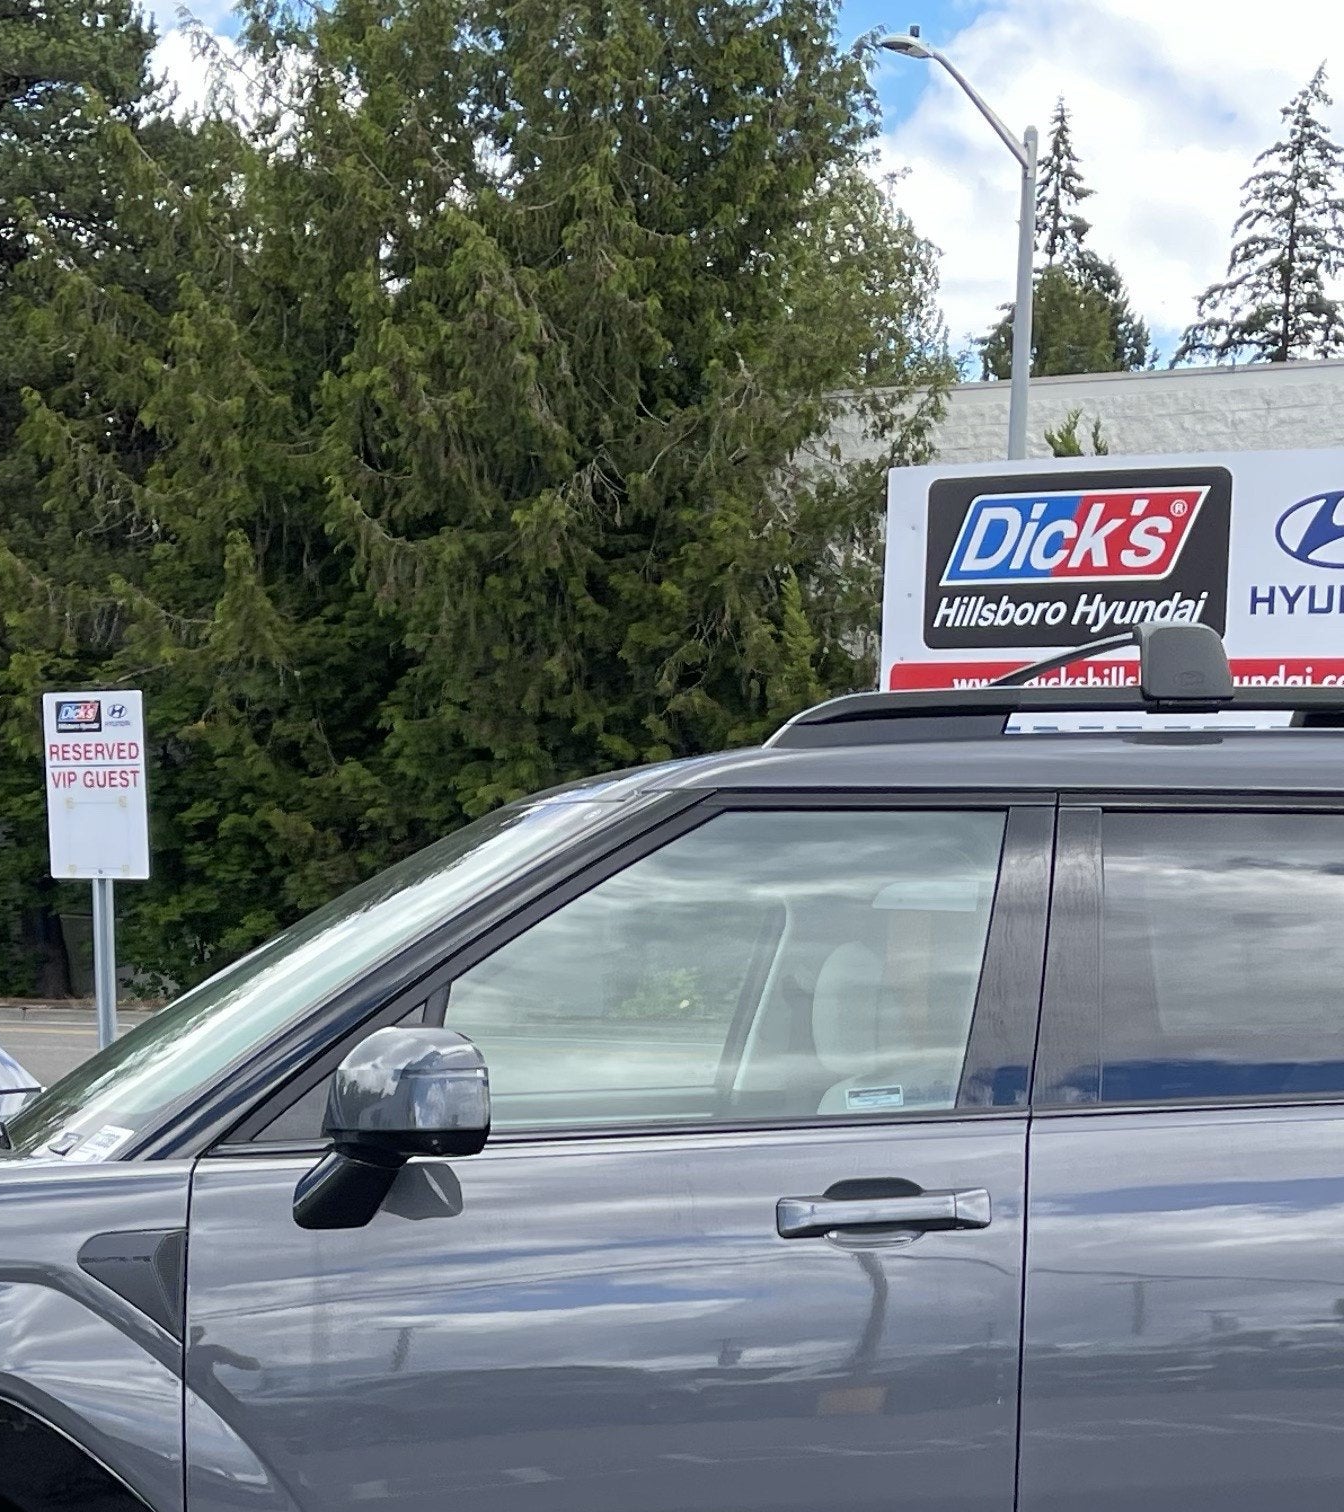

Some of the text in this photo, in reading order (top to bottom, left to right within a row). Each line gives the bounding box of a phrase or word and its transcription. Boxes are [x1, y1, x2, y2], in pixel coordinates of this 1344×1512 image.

[959, 498, 1174, 572] Dick's
[933, 591, 1209, 633] Hillsboro Hyundai
[49, 742, 140, 761] RESERVED
[51, 770, 140, 788] VIP GUEST
